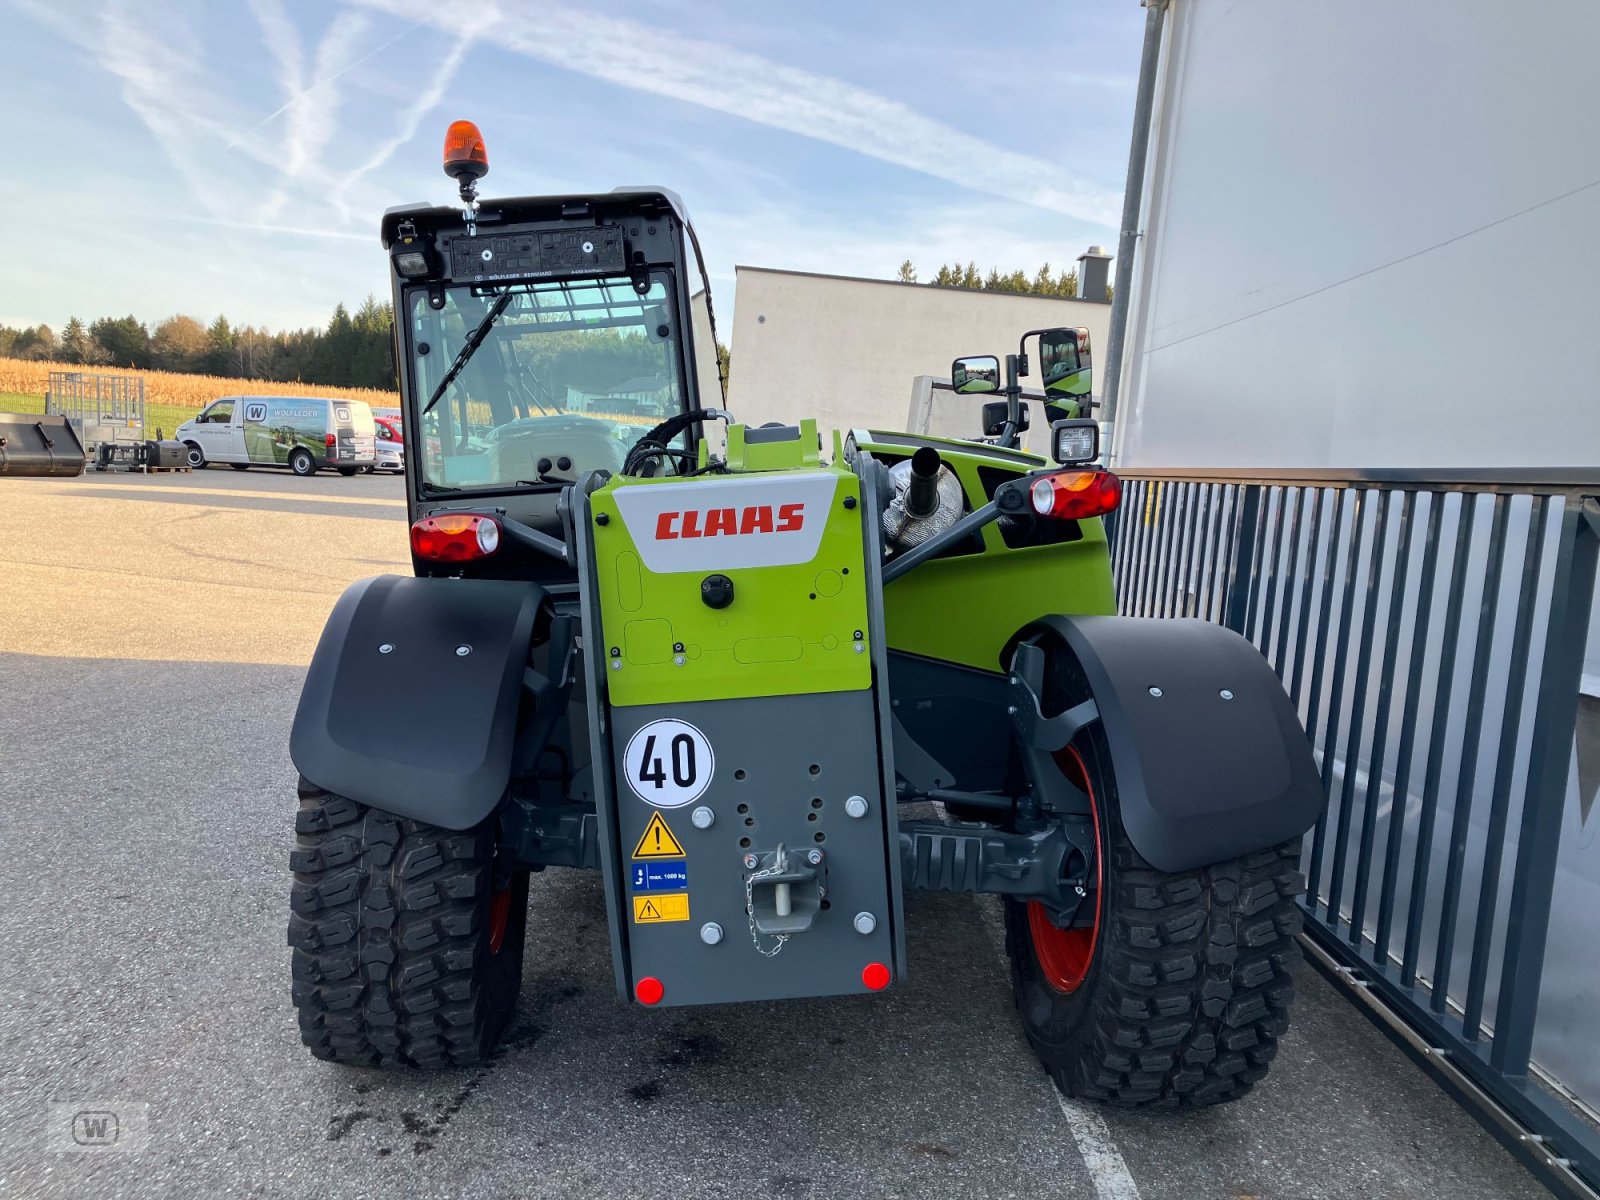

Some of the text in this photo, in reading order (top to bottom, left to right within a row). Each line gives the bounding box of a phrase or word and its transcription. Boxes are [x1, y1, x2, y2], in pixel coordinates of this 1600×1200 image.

[250, 407, 263, 418] W
[339, 409, 348, 419] W
[655, 503, 805, 540] CLAAS
[639, 733, 697, 788] 40
